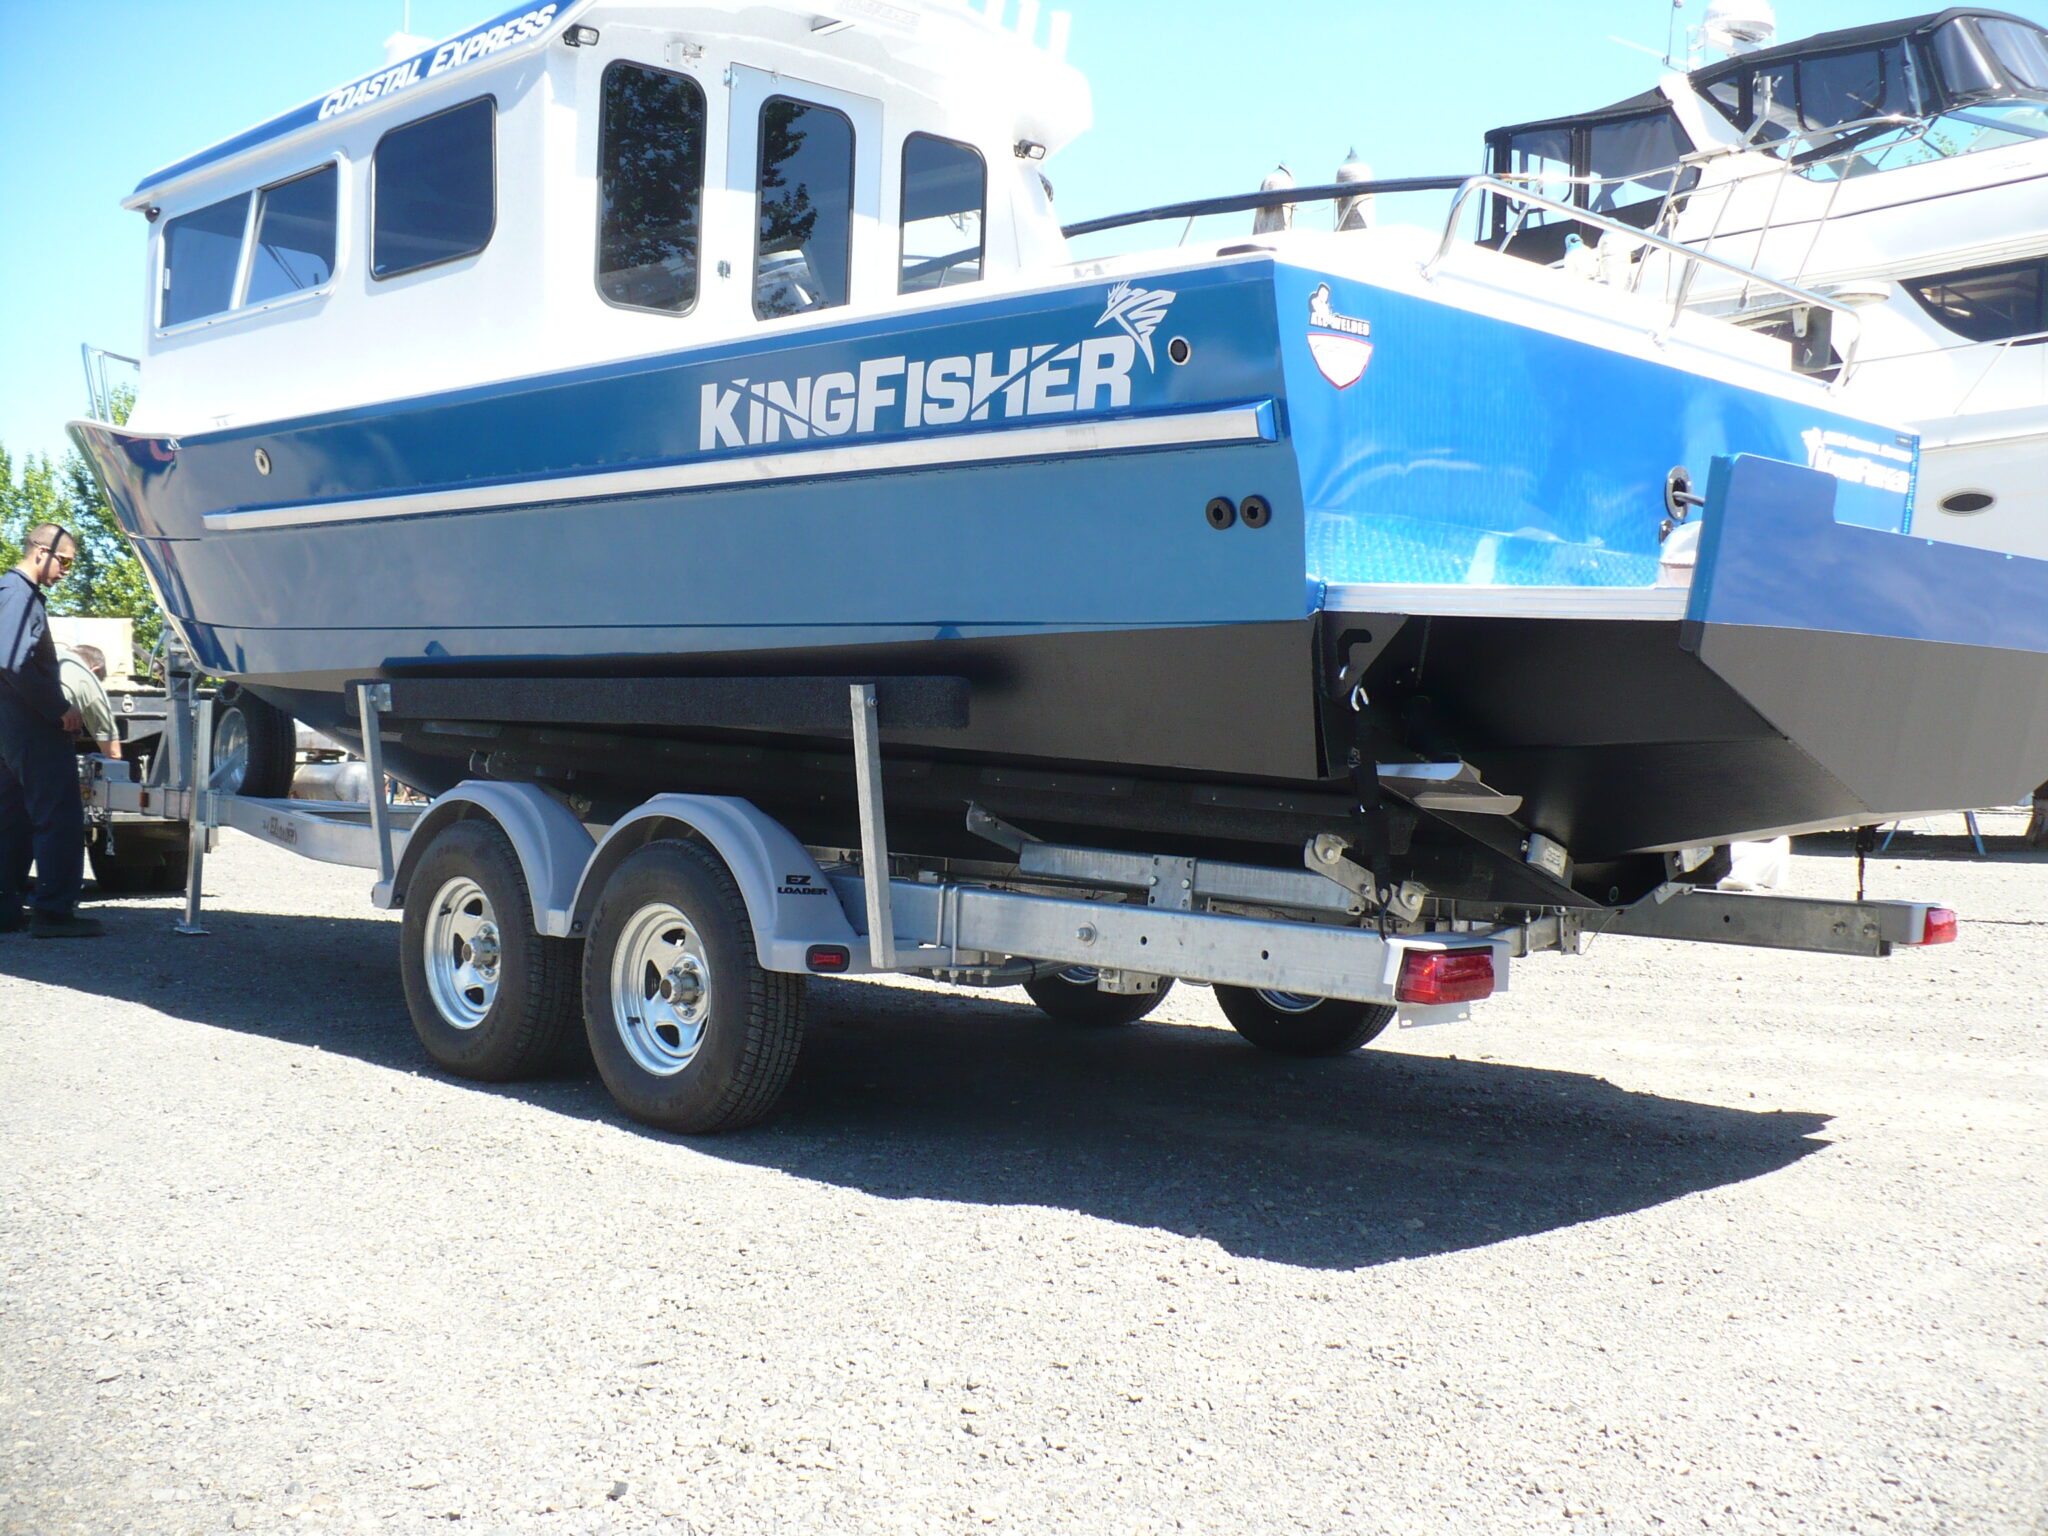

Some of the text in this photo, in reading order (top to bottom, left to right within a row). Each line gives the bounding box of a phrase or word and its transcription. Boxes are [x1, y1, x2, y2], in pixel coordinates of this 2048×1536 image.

[318, 3, 557, 121] COASTAL EXPRESS
[700, 335, 1135, 450] KINGFISHER
[777, 887, 828, 895] LOADER
[786, 875, 811, 885] EZ
